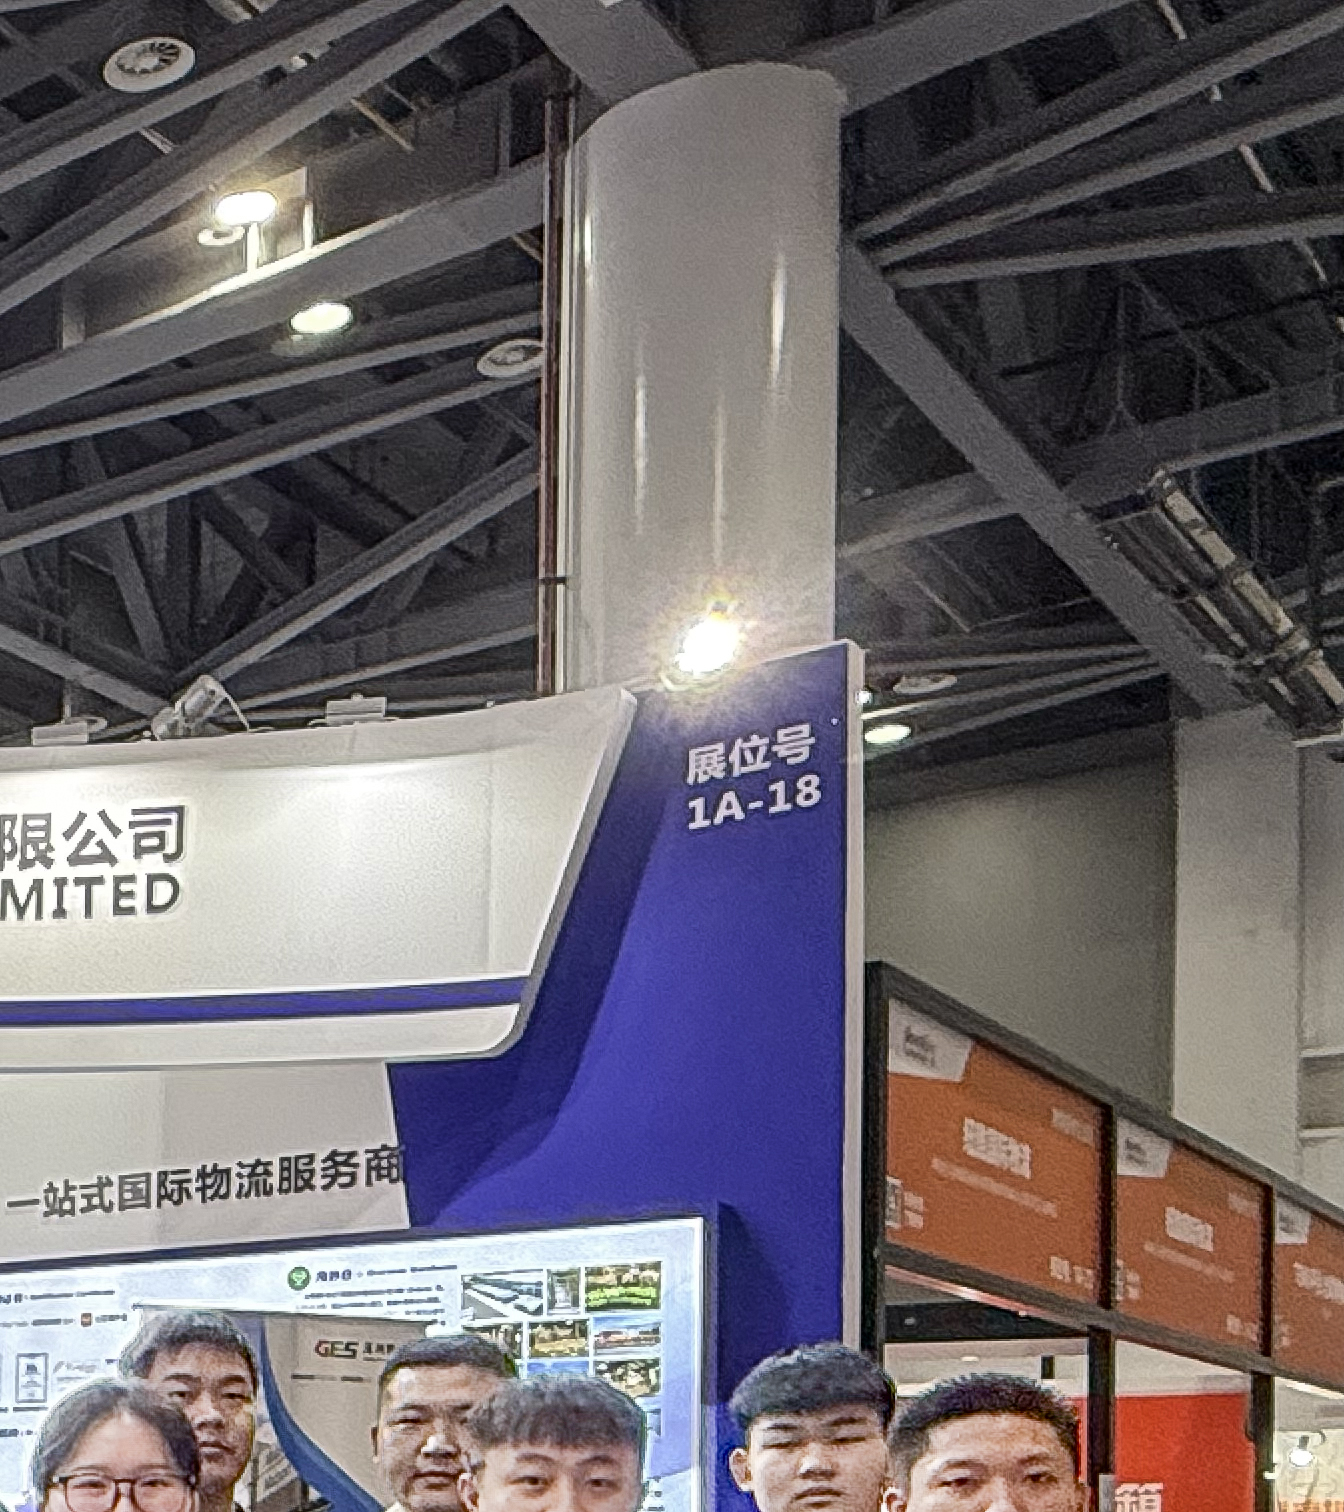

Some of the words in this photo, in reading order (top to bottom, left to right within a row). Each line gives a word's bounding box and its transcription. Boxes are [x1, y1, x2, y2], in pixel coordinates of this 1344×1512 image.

[686, 723, 816, 786] 展位号
[688, 774, 822, 830] 1A-18
[7, 1143, 405, 1218] 一站式国际物流服务商
